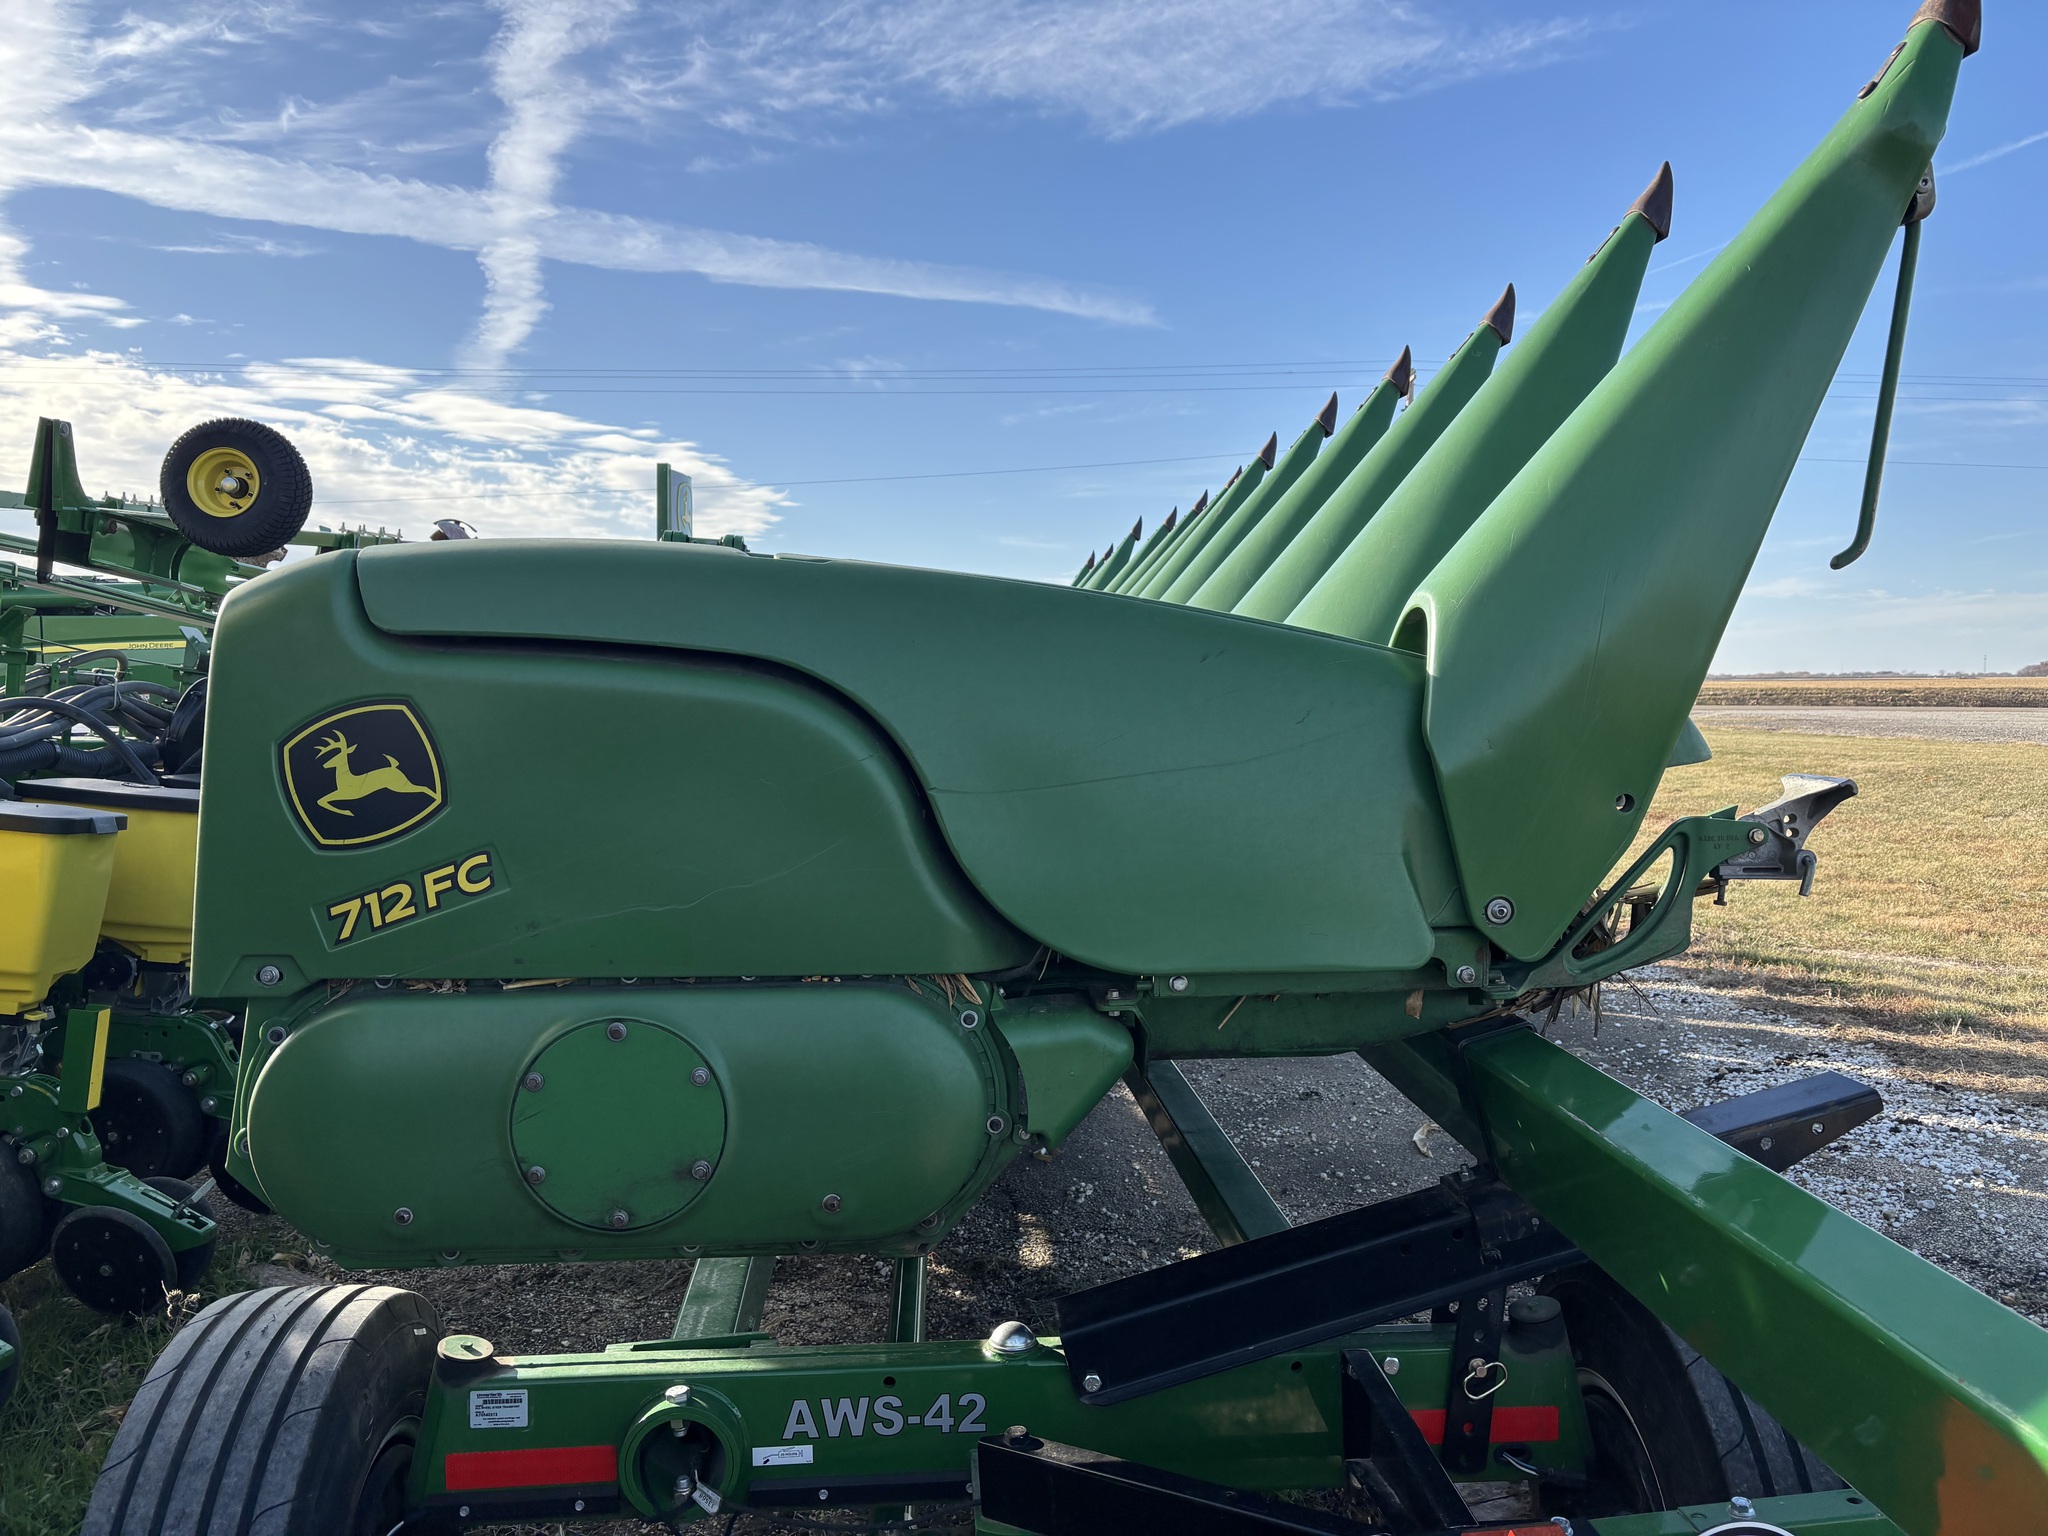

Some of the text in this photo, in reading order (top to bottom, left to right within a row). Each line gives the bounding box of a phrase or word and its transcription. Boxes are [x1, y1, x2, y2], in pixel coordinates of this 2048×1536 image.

[328, 852, 493, 943] 712 FC
[781, 1393, 988, 1440] AWS-42
